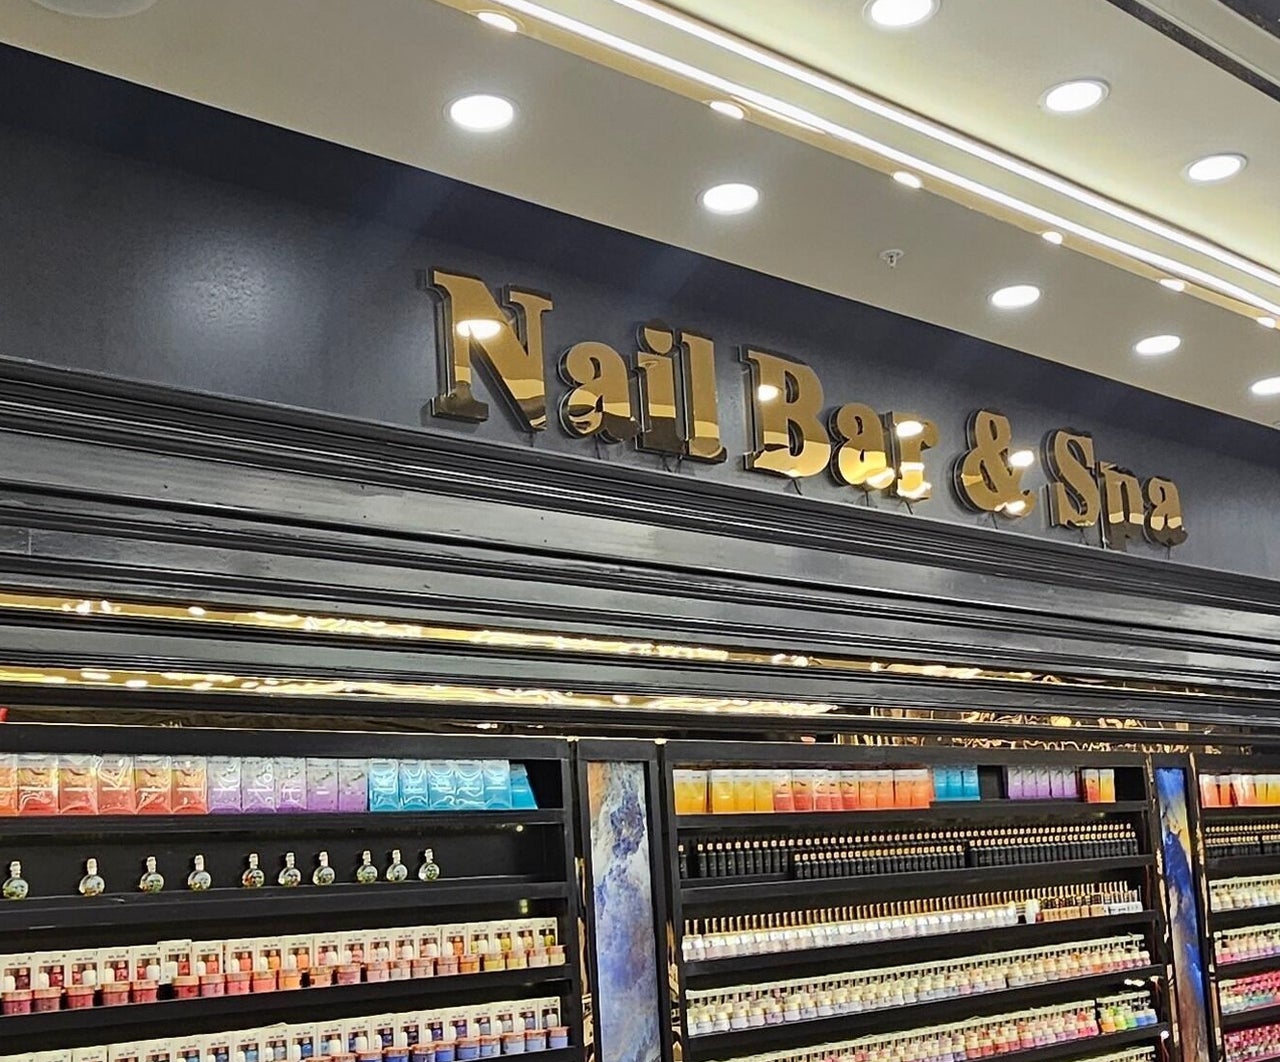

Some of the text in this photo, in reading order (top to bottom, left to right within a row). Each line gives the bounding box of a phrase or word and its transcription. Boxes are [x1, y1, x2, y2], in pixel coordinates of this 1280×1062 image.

[426, 268, 1188, 549] Nail Bar & Spa
